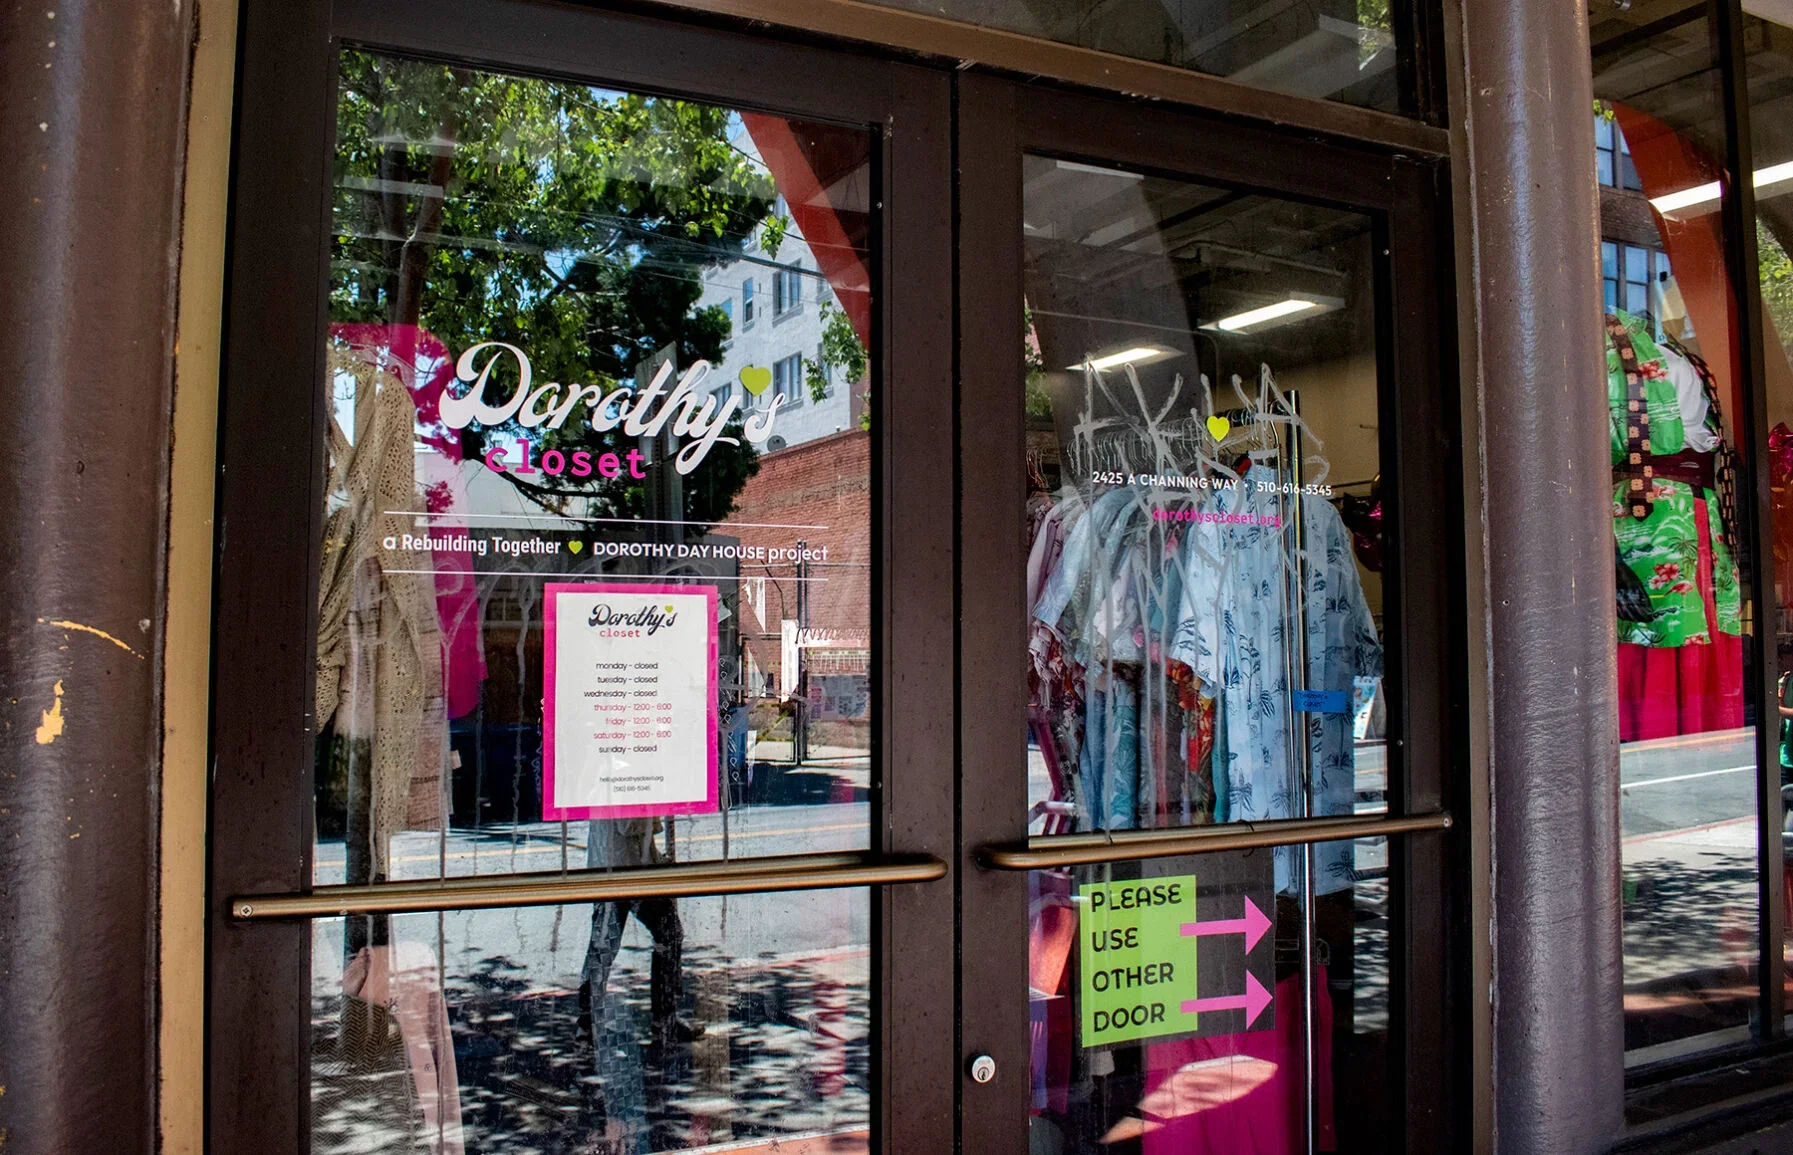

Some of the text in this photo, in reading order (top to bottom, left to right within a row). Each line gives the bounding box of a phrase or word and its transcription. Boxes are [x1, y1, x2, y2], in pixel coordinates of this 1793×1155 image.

[485, 439, 647, 479] closet
[1092, 471, 1332, 496] 2425 A CHANNING WAY 510-616-5345
[1153, 507, 1281, 528] dorothyscloset.org
[383, 534, 561, 556] a Rebuilding Together
[593, 542, 829, 563] DOROTHY DAY HOUSE project
[600, 628, 641, 638] closet
[596, 662, 627, 671] monday
[634, 662, 659, 670] closed
[597, 676, 627, 684] tuesday
[584, 690, 627, 698] wednesday
[594, 704, 626, 712] thursday
[594, 731, 626, 740] saturday
[599, 745, 626, 754] sunday
[1091, 883, 1182, 912] PLEASE
[1092, 927, 1139, 952] USE
[1092, 962, 1174, 992] OTHER
[1093, 1002, 1166, 1032] DOOR
